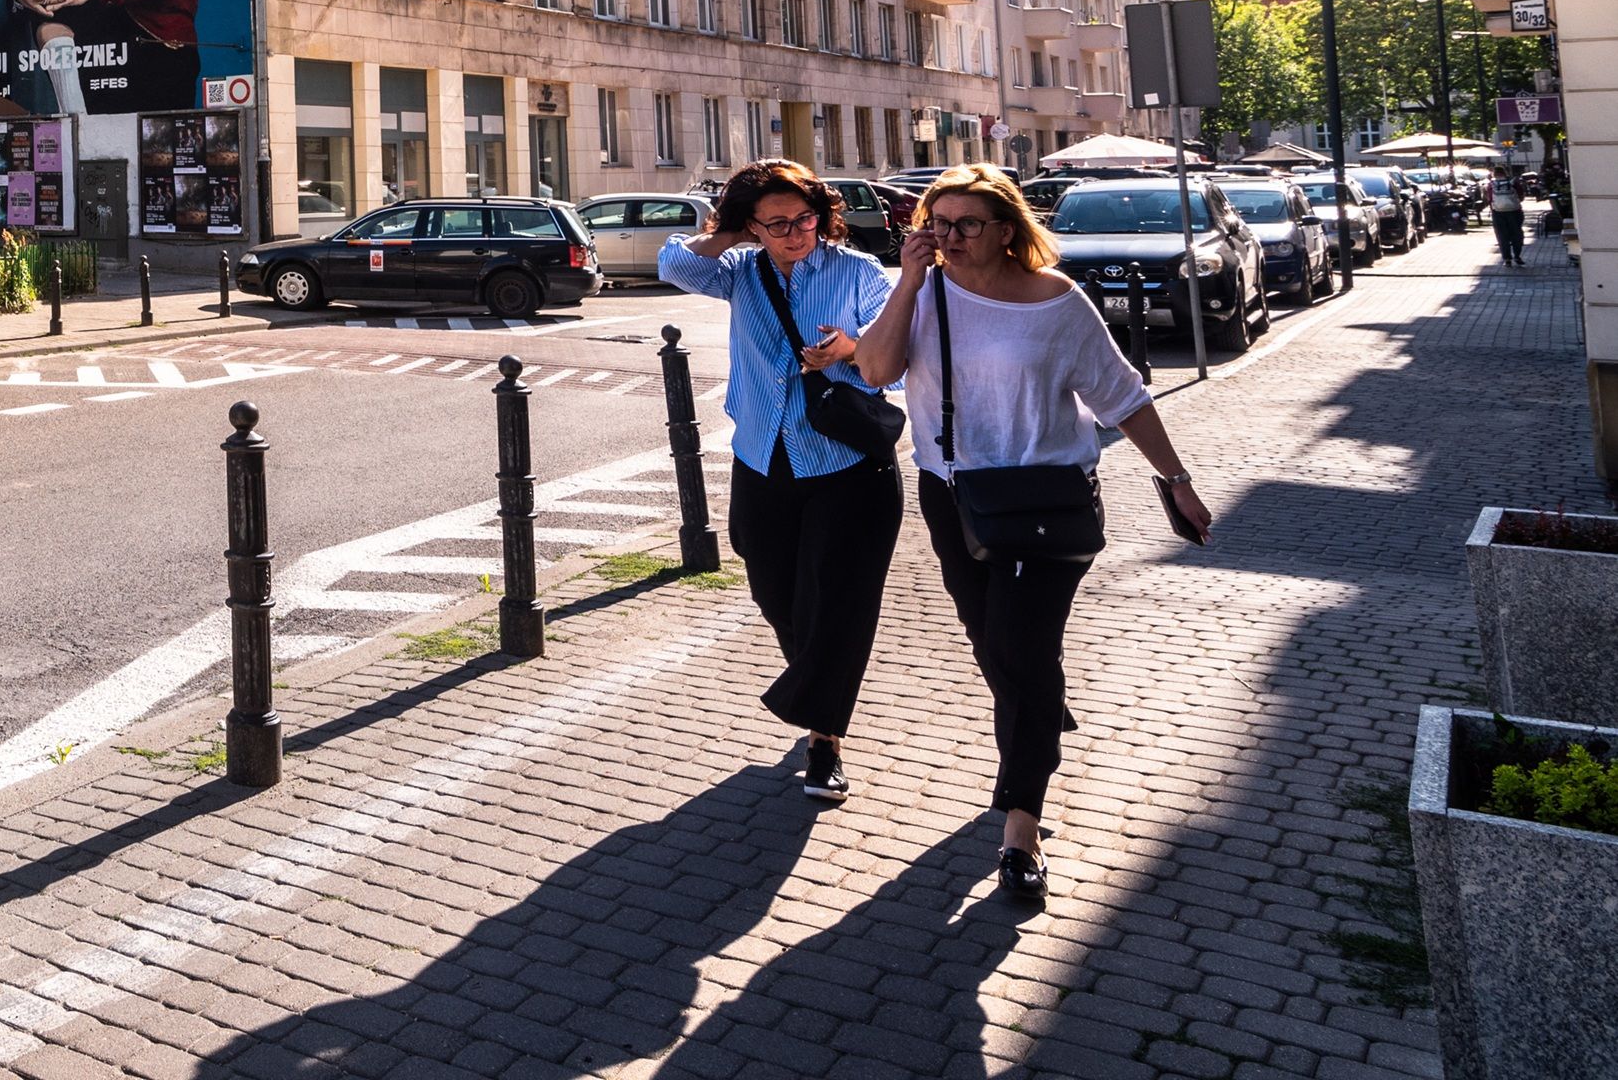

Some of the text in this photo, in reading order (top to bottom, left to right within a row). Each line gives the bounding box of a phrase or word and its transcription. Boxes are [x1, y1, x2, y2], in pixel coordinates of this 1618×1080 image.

[1515, 10, 1545, 26] 30/32
[18, 42, 128, 72] SPOŁECZNEJ
[100, 77, 129, 89] FES
